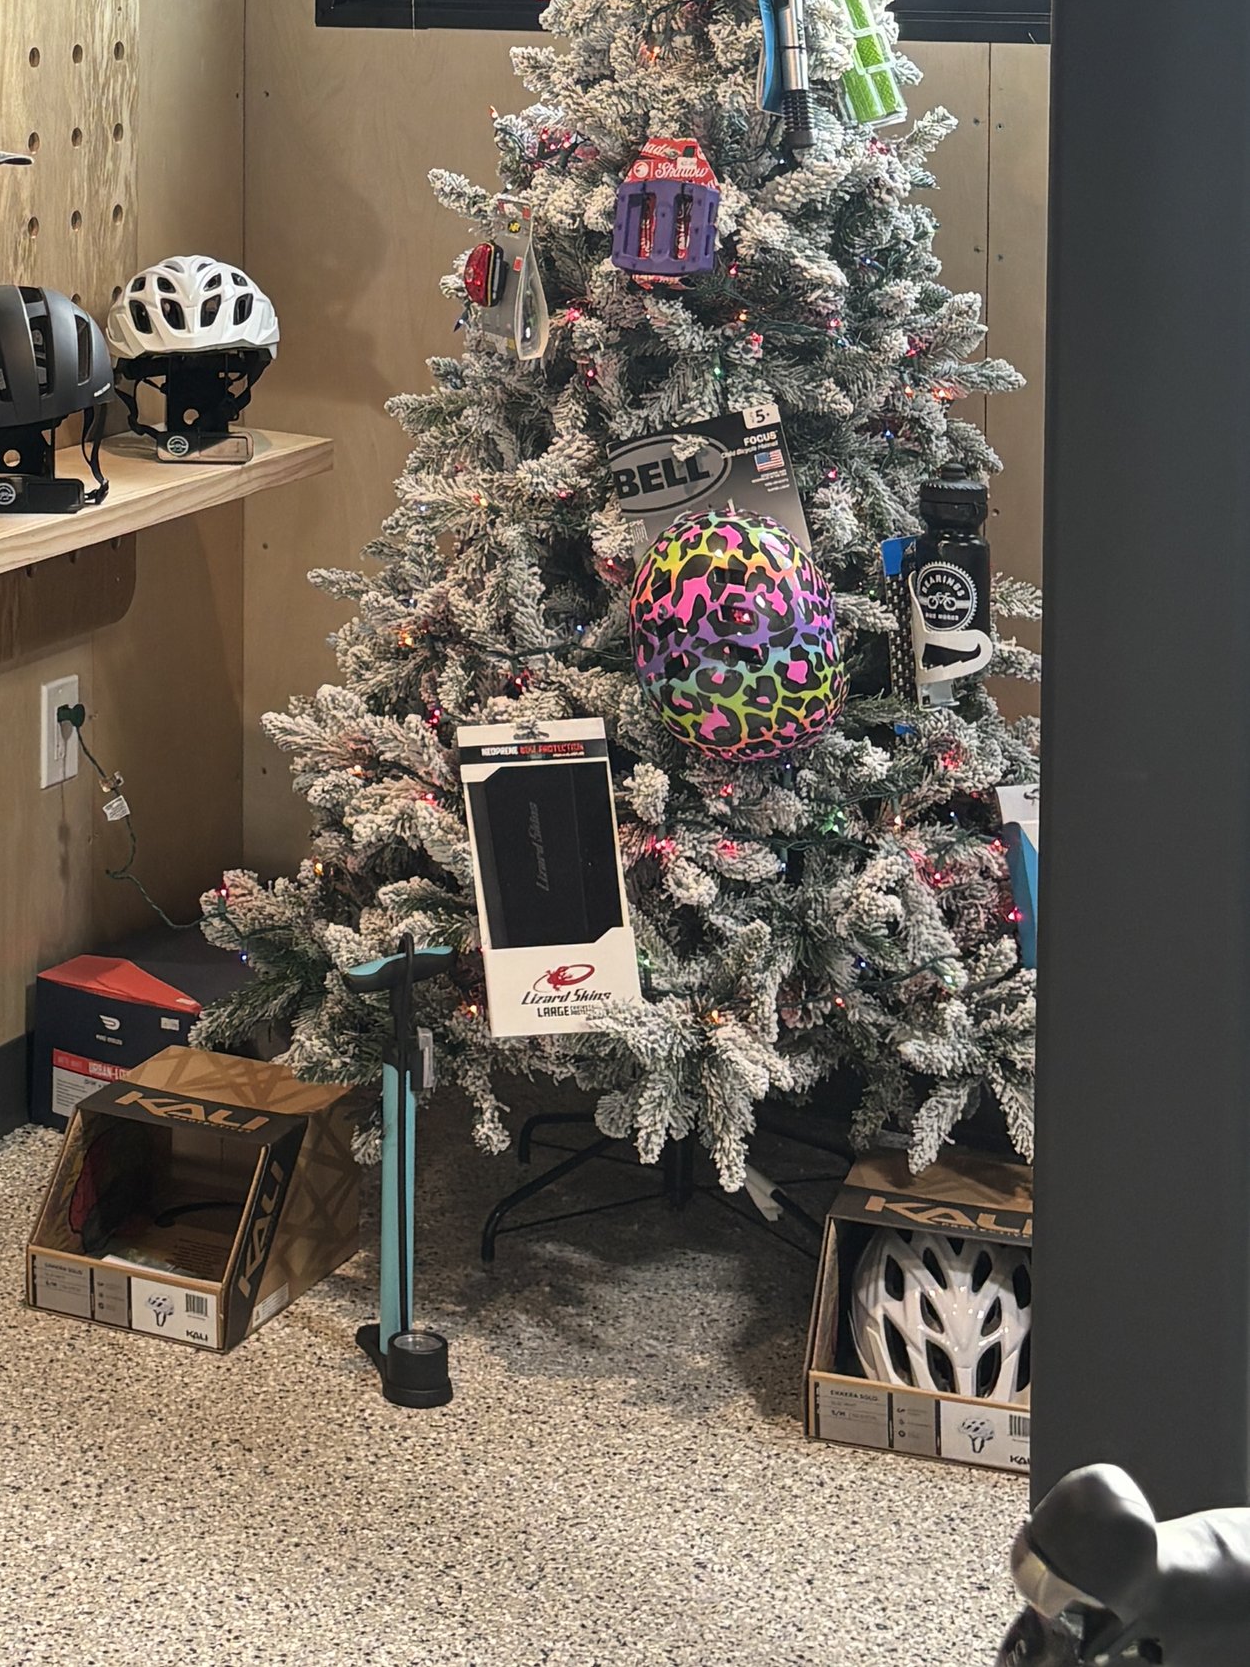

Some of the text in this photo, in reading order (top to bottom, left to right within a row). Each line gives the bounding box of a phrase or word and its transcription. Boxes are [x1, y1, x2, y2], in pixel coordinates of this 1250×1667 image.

[743, 431, 777, 446] FOCUS
[613, 457, 710, 500] BELL
[521, 988, 611, 1005] Lizard Skins
[537, 1006, 569, 1017] LARGE
[115, 1090, 269, 1131] KALI
[238, 1161, 284, 1298] KALI
[186, 1329, 208, 1342] KALI
[1010, 1455, 1030, 1465] KA
